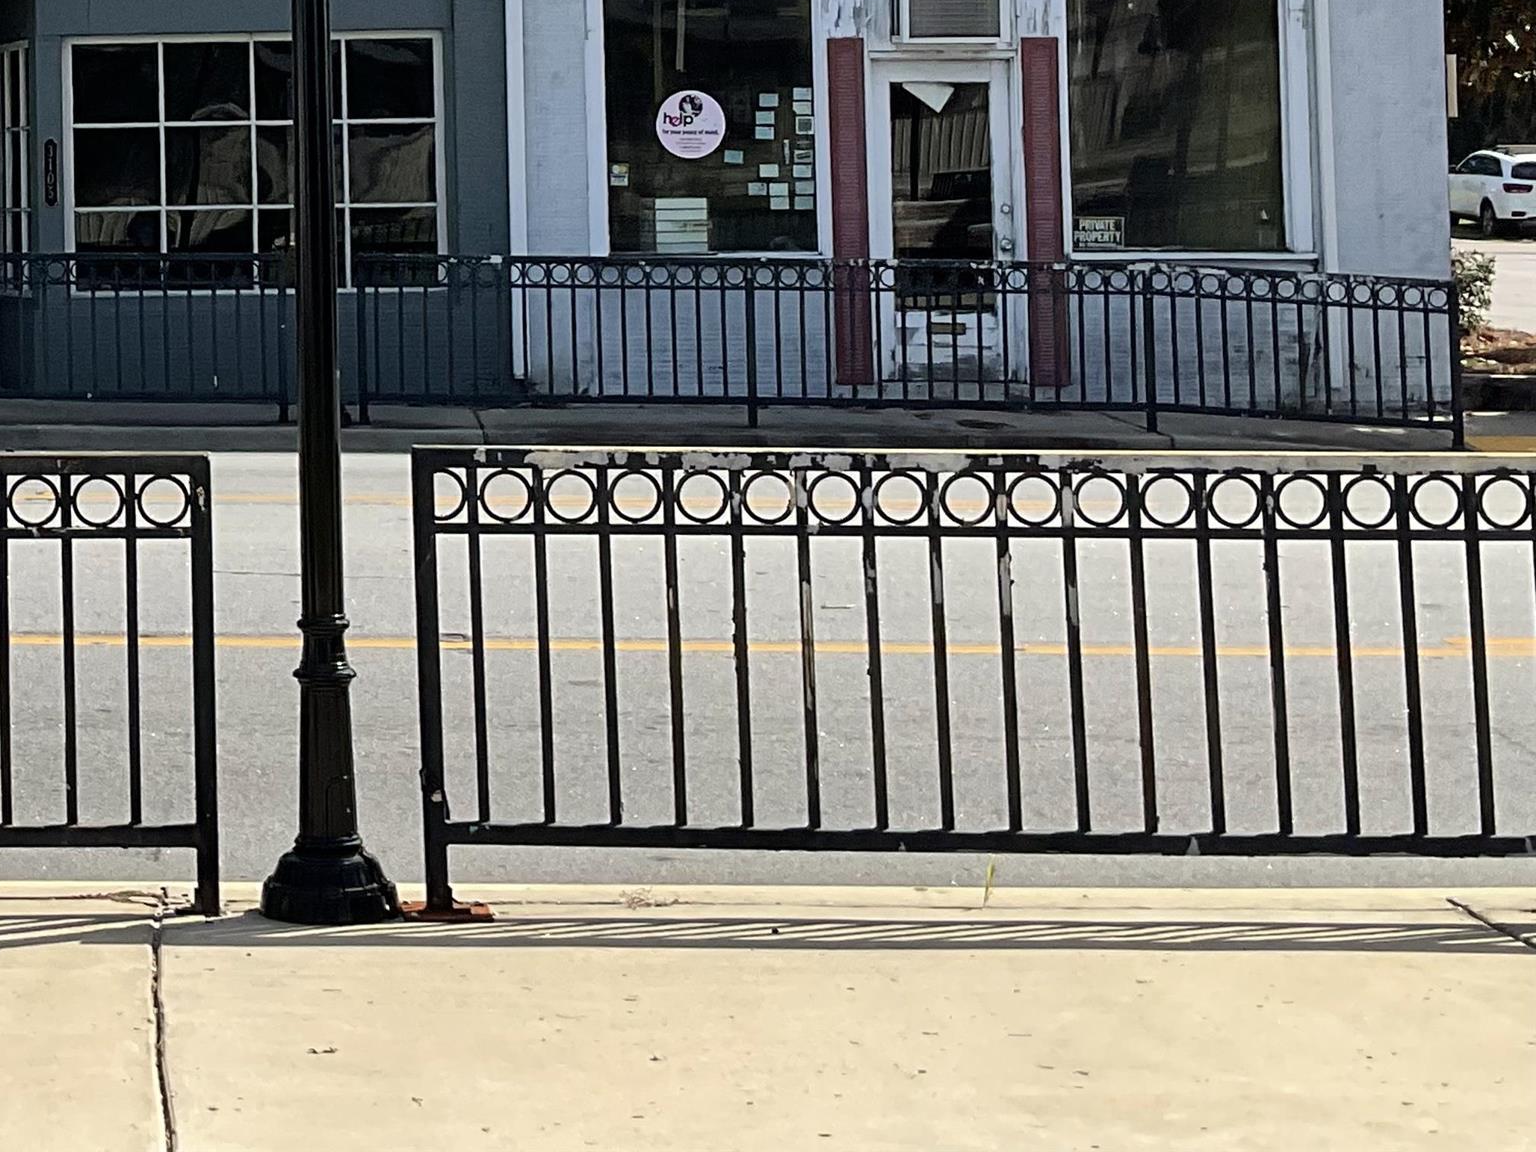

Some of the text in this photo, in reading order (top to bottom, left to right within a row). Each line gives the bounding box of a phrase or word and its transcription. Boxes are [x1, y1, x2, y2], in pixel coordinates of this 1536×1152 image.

[663, 111, 694, 127] help
[1078, 219, 1116, 230] PRIVATE
[1073, 231, 1121, 242] PROPERTY
